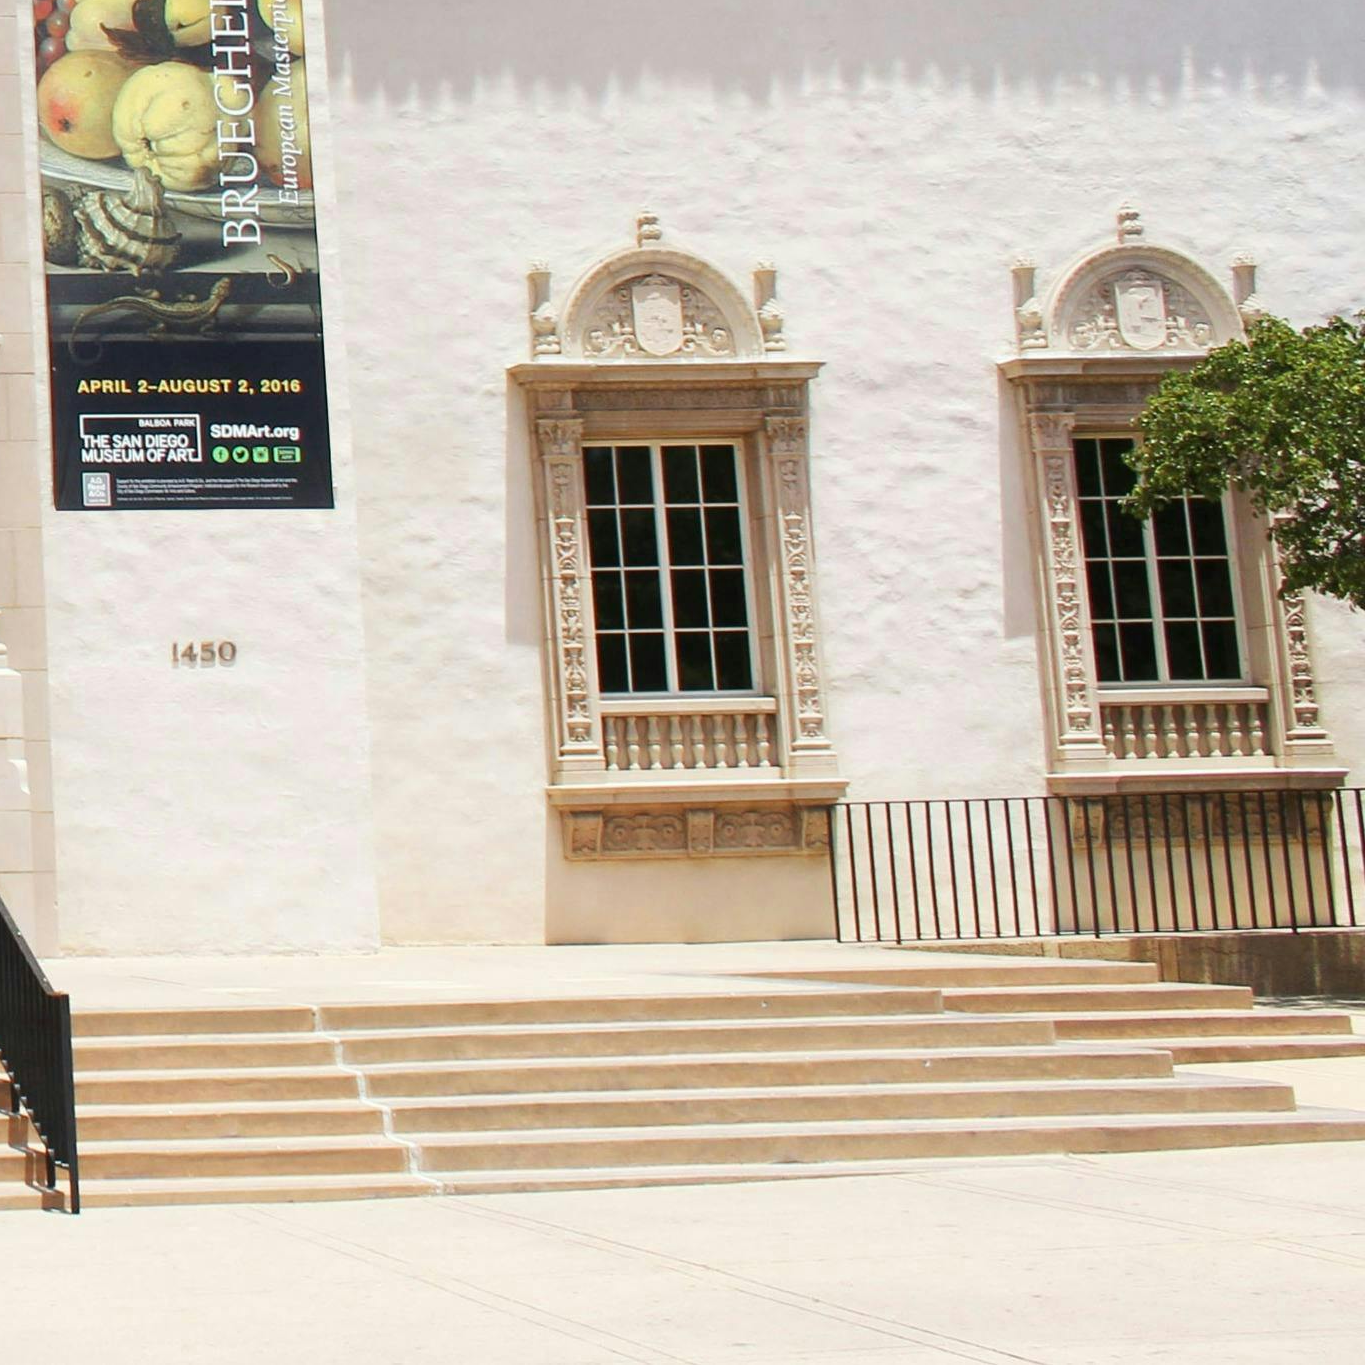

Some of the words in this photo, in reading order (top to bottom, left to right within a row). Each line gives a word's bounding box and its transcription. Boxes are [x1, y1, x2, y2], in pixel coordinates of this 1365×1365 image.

[278, 104, 303, 206] European
[77, 379, 131, 394] APRIL
[237, 379, 254, 395] 2,
[260, 379, 301, 393] 2016
[139, 418, 170, 428] BALBOA
[173, 418, 195, 427] PARK
[210, 423, 300, 441] SDMArt.org
[83, 435, 110, 448] THE
[112, 435, 142, 448] SAN
[145, 434, 189, 448] DIEGO
[81, 448, 144, 463] MUSEUM
[146, 448, 165, 462] OF
[166, 448, 195, 462] ART
[171, 641, 237, 662] 1450
